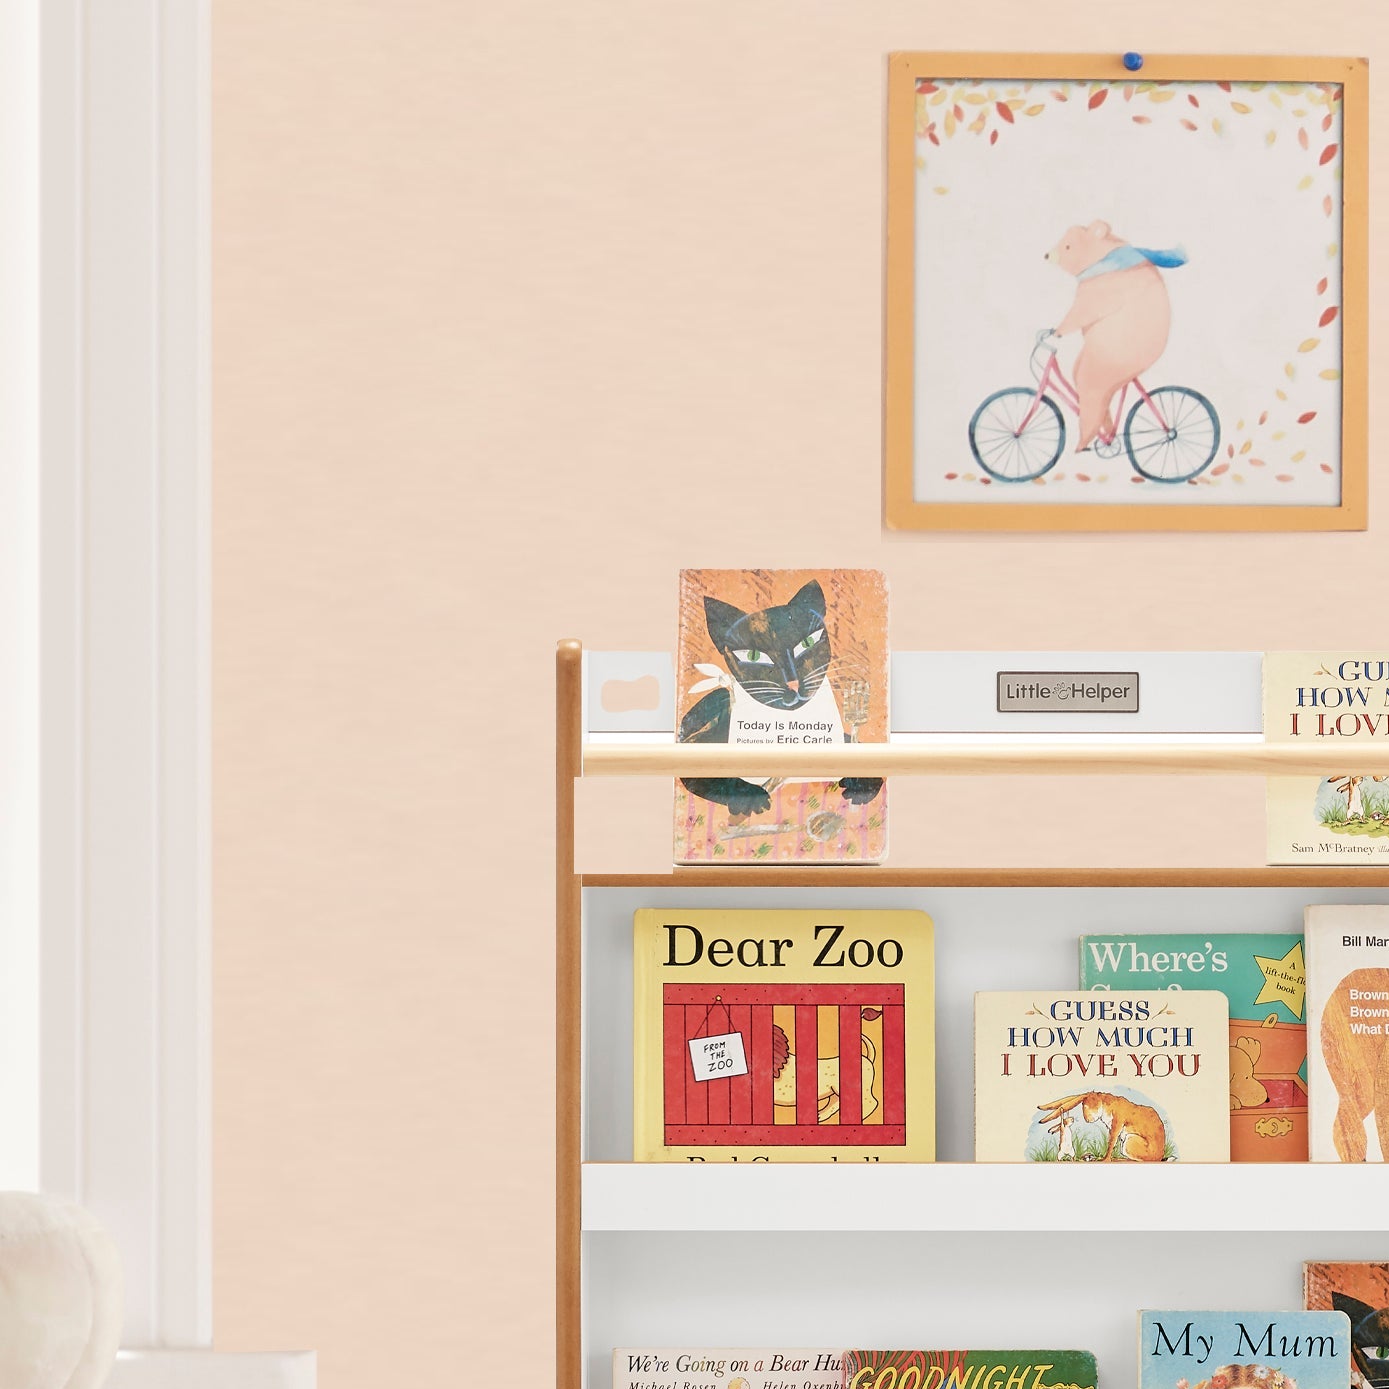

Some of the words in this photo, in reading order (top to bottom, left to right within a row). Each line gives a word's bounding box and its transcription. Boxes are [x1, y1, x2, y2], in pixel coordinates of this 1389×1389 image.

[1007, 682, 1051, 699] Little
[1071, 682, 1130, 703] Helper
[1295, 686, 1373, 707] HOW
[737, 720, 771, 732] Today
[775, 721, 785, 731] Is
[788, 721, 834, 732] Monday
[1290, 713, 1301, 736] I
[777, 735, 799, 744] Eric
[803, 735, 833, 744] Carle
[1291, 843, 1314, 853] Sam
[1318, 843, 1375, 856] McBratney
[663, 925, 793, 967] Dear
[813, 925, 904, 967] Zoo
[1342, 936, 1362, 947] Bill
[1088, 942, 1228, 972] Where's
[1290, 962, 1296, 970] A
[1276, 982, 1296, 994] book
[1350, 989, 1389, 1000] Brown
[1050, 1000, 1150, 1021] GUESS
[1350, 1006, 1389, 1018] Brown
[1350, 1024, 1382, 1034] What
[1007, 1027, 1084, 1048] HOW
[1096, 1027, 1194, 1048] MUCH
[704, 1041, 726, 1053] FROM
[710, 1050, 725, 1060] THE
[708, 1058, 733, 1072] ZOO
[1000, 1054, 1012, 1076] I
[1027, 1054, 1118, 1078] LOVE
[1127, 1054, 1202, 1078] YOU
[1152, 1322, 1213, 1364] My
[1233, 1323, 1338, 1357] Mum
[628, 1355, 670, 1373] We're
[675, 1355, 726, 1378] Going
[730, 1360, 749, 1372] on
[754, 1360, 764, 1372] a
[769, 1355, 809, 1372] Bear
